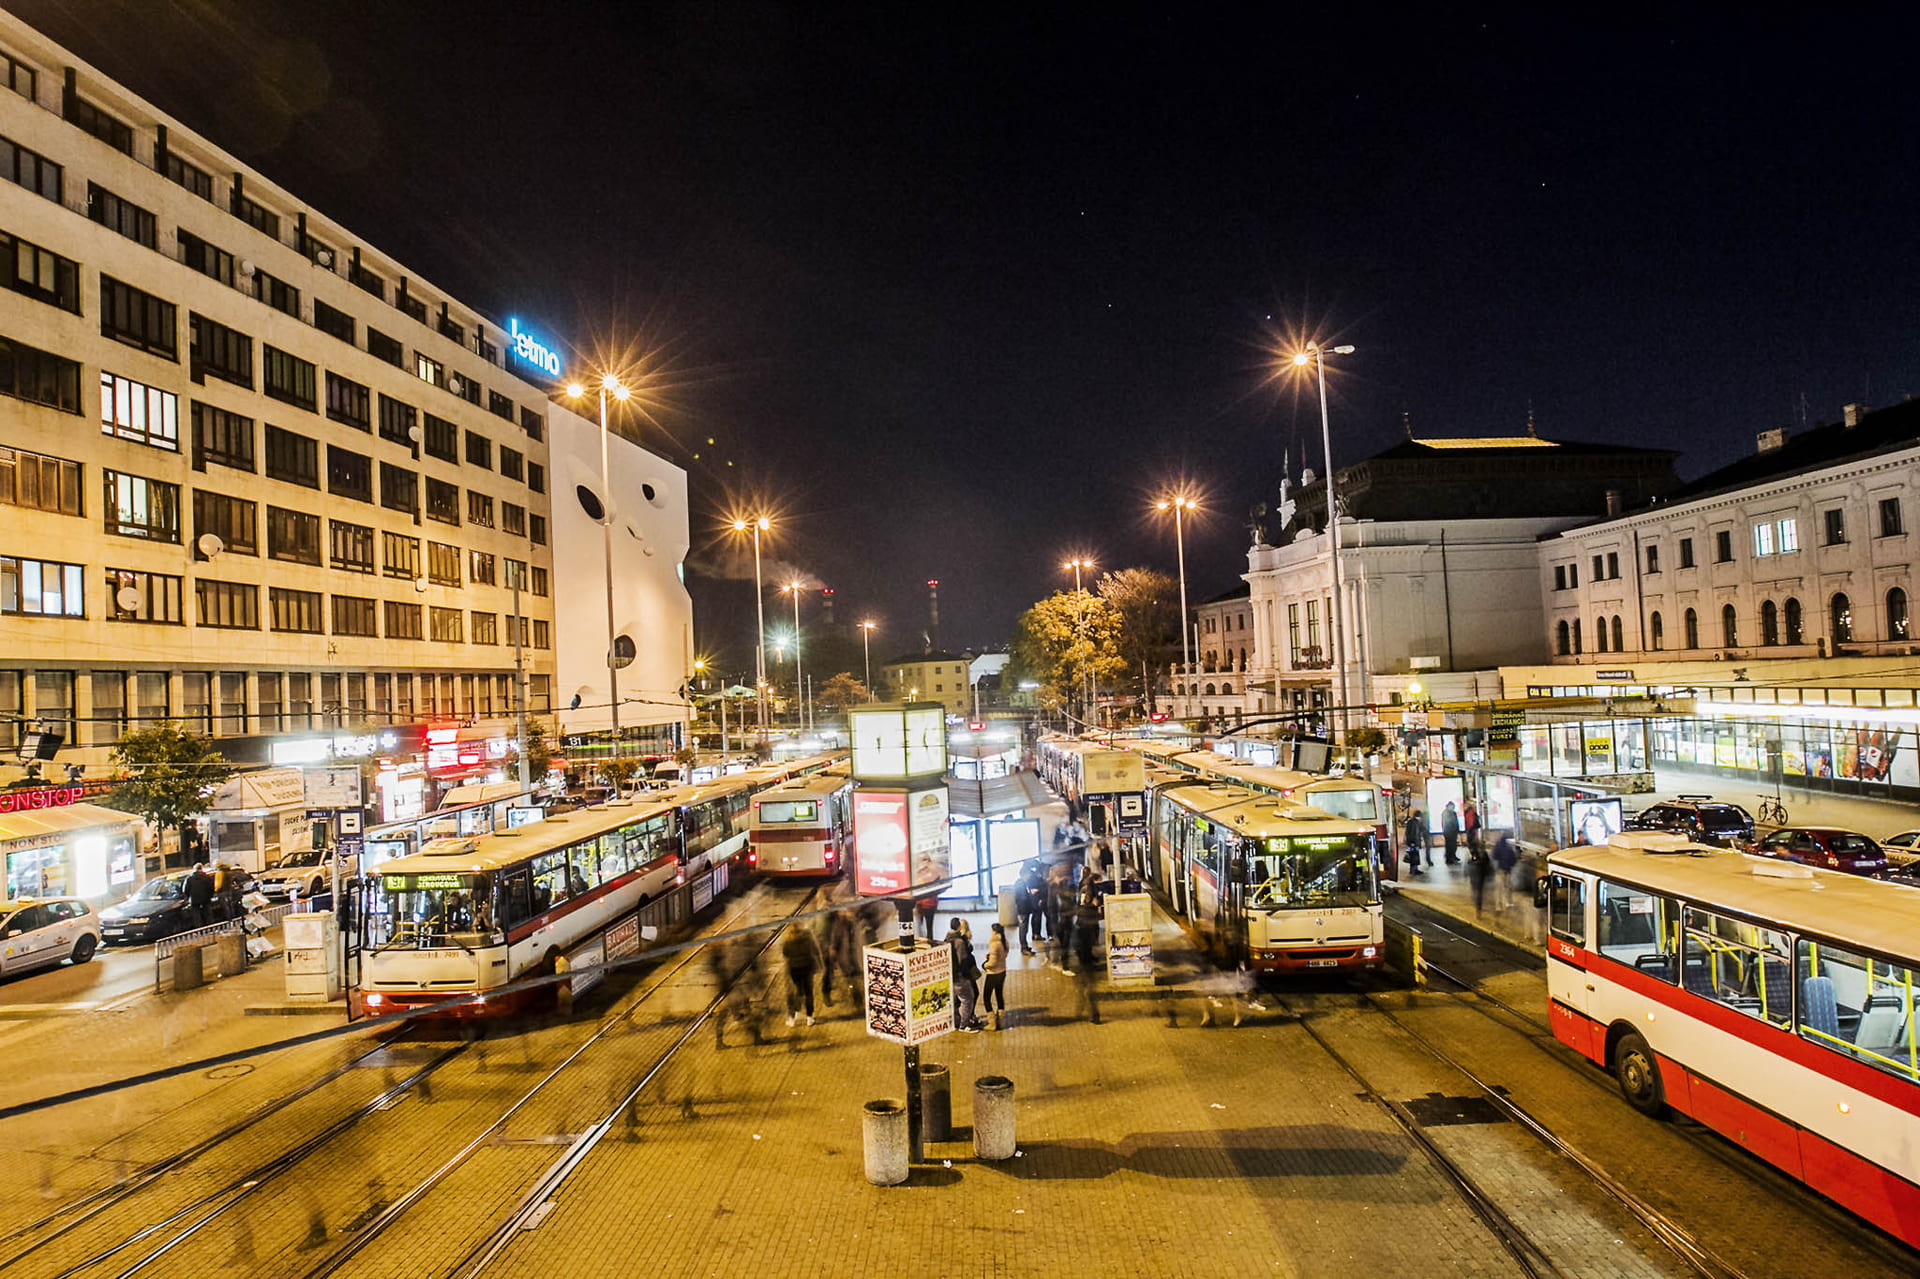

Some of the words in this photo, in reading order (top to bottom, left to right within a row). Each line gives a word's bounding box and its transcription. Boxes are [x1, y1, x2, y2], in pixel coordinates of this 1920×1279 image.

[9, 837, 36, 850] NON
[909, 948, 949, 967] KVĚTINY
[912, 1021, 949, 1041] ZDARMA
